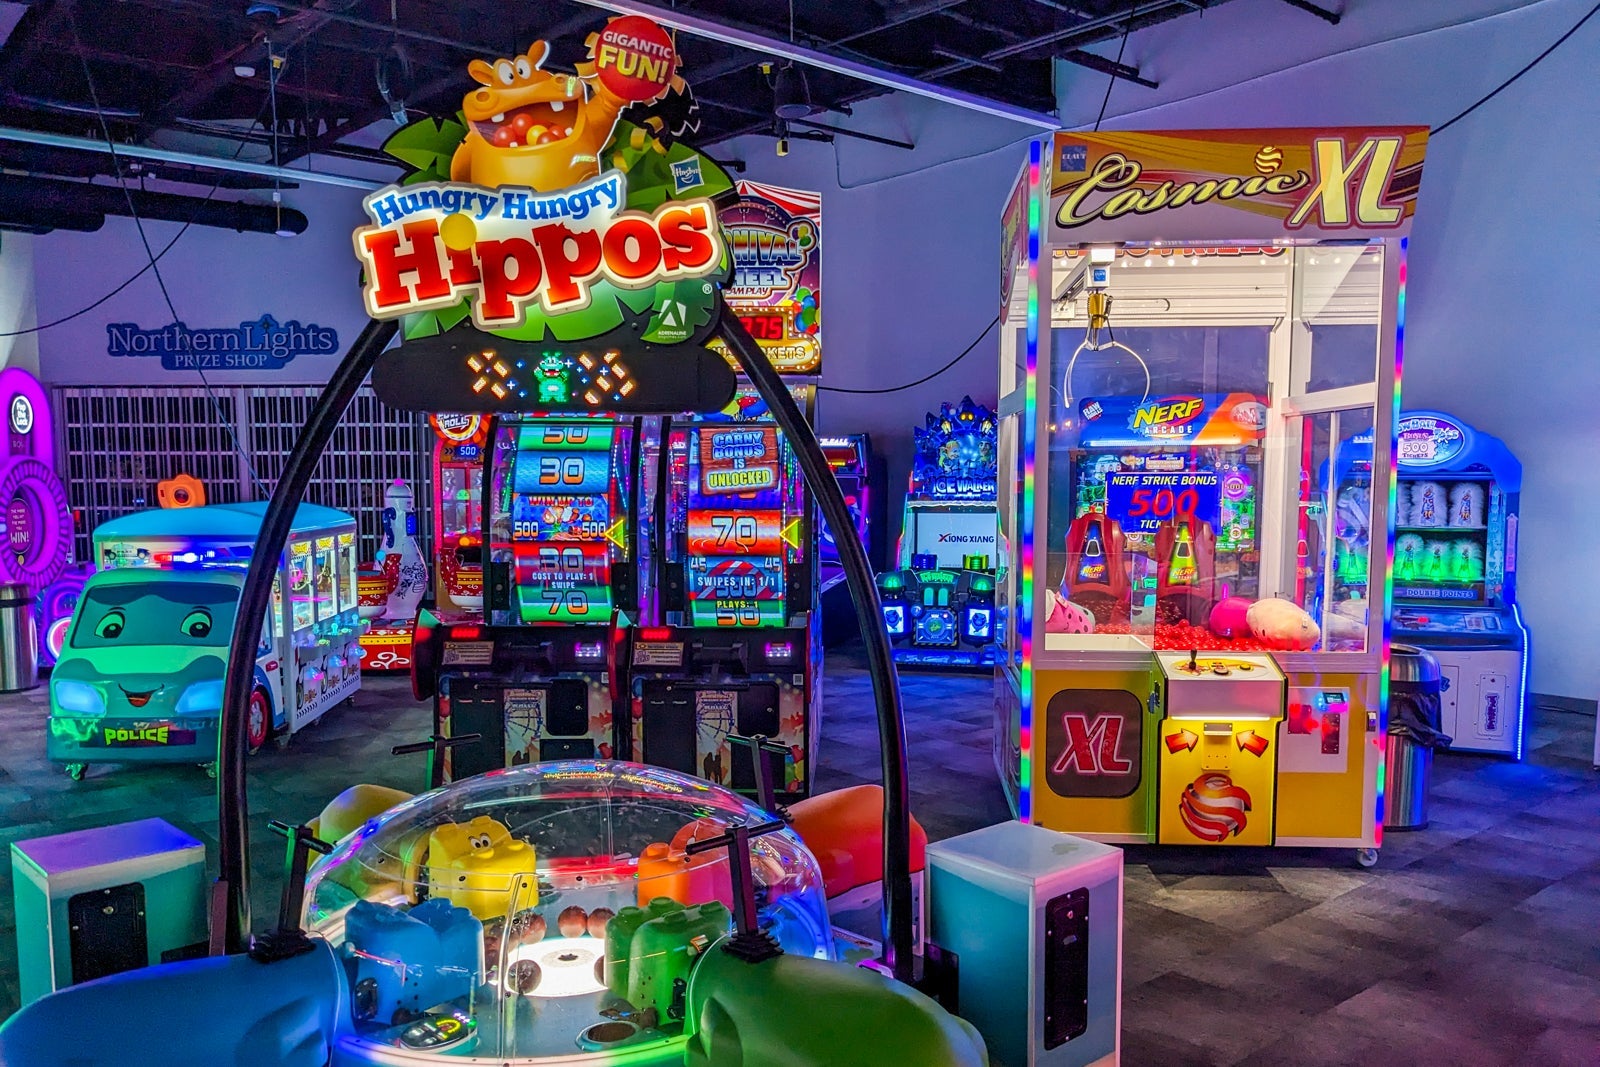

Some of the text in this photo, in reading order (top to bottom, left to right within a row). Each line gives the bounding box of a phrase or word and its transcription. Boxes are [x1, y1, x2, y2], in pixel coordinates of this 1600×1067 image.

[603, 31, 672, 58] GIGANTIC
[598, 44, 669, 84] FUN!
[1056, 139, 1401, 228] Cosmic XL
[372, 178, 617, 227] Hungry Hungry
[364, 206, 714, 321] Hippos
[745, 287, 768, 295] PLAY
[110, 322, 333, 357] Northern Lights
[175, 354, 267, 367] PRIZE SHOP
[1133, 399, 1202, 428] NERF
[543, 426, 588, 443] 50
[1144, 425, 1193, 434] ARCADE
[713, 432, 763, 446] CARNY
[460, 446, 477, 455] 500
[713, 445, 764, 459] BONUS
[1402, 442, 1429, 453] 500
[539, 457, 585, 484] 30
[733, 458, 745, 468] IS
[709, 470, 770, 487] UNLOCKED
[932, 479, 956, 493] ICE
[1112, 475, 1217, 485] NERF STRIKE BONUS
[529, 496, 594, 507] WIN UP TO
[1128, 489, 1199, 517] 500
[514, 522, 539, 537] 500
[582, 522, 606, 537] 500
[711, 516, 757, 546] 70
[10, 531, 29, 544] WIN!
[938, 533, 995, 543] XIONG XIANG
[540, 547, 585, 572] 30
[690, 557, 706, 572] 45
[764, 557, 781, 572] 45
[566, 572, 587, 580] PLAY:
[589, 572, 594, 580] 1
[1082, 564, 1105, 574] NERF
[1173, 566, 1196, 576] NERF
[551, 581, 576, 589] SWIPE
[697, 576, 775, 586] SWIPES IN: 1/1
[1407, 588, 1474, 598] DOUBLE POINTS
[542, 591, 588, 614] 70
[717, 606, 760, 626] 50
[104, 726, 169, 746] POLICE
[1054, 715, 1132, 774] XL
